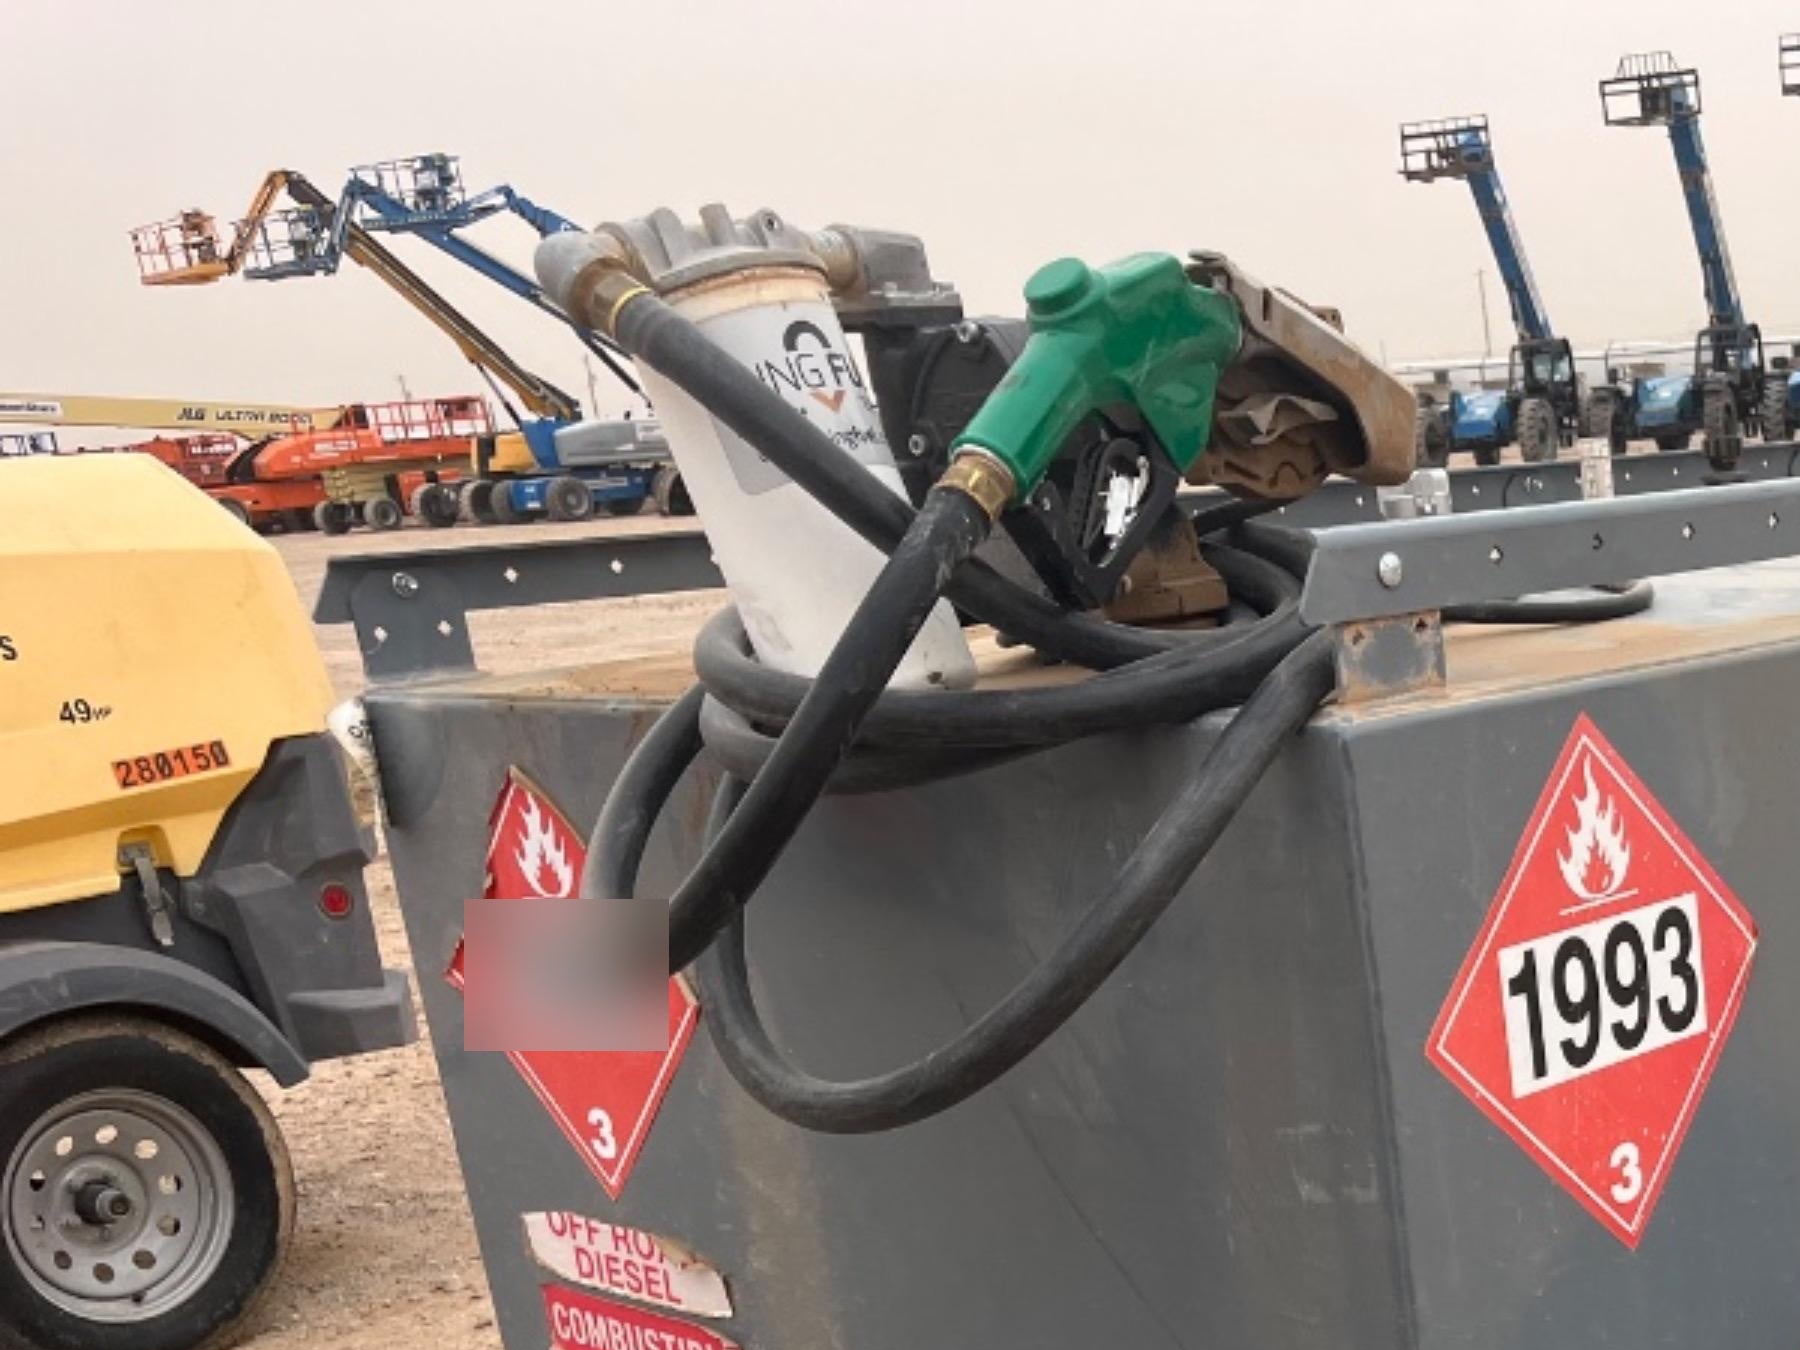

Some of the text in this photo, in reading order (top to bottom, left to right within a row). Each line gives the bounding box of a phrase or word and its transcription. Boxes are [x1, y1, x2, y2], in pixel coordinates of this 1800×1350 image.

[754, 353, 825, 397] ING
[114, 740, 231, 789] 280150
[1507, 905, 1700, 1081] 1993
[587, 1106, 617, 1159] 3
[1609, 1141, 1643, 1204] 3
[575, 1246, 683, 1305] DIESEL
